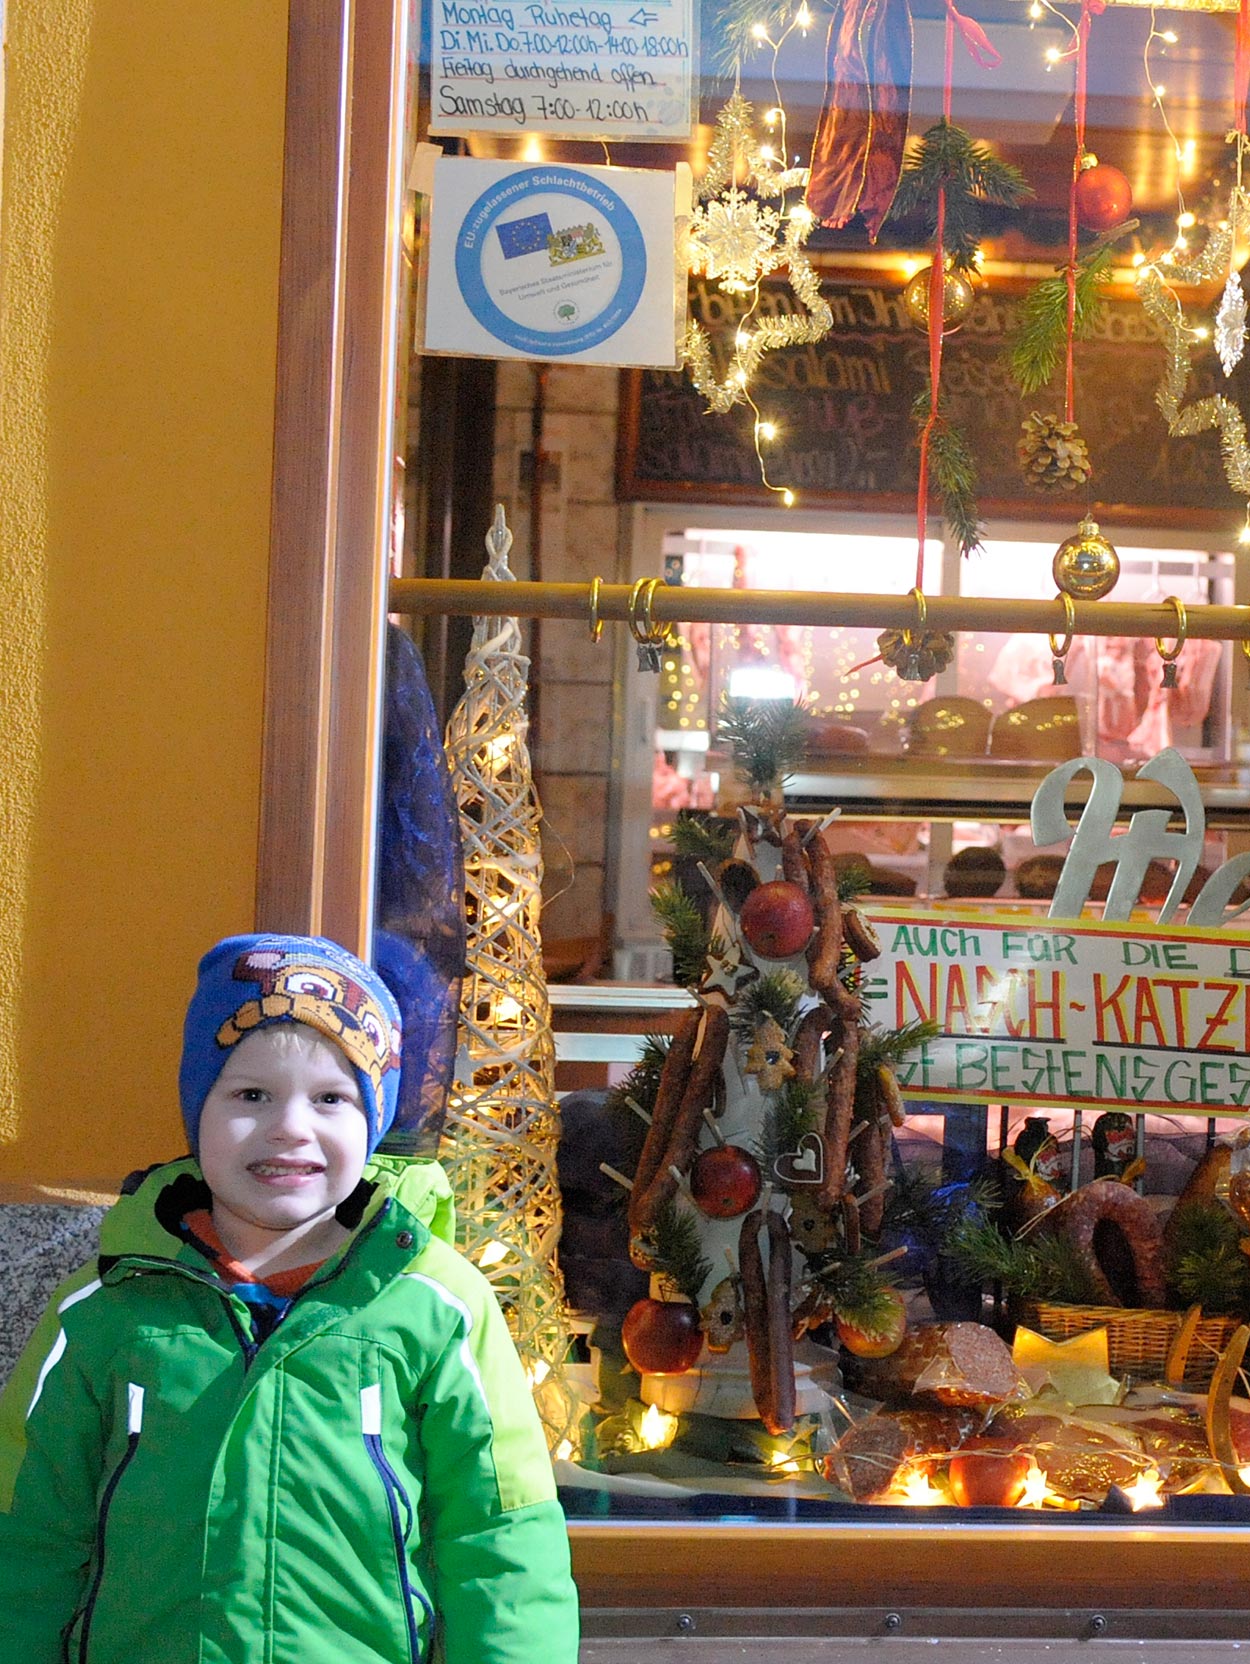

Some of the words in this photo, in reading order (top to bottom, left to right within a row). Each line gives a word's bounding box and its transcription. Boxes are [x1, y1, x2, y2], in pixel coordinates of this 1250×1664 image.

[442, 2, 515, 31] Montag
[525, 4, 613, 34] Ruhetag
[505, 58, 601, 89] durchgehend
[611, 62, 657, 93] offen
[440, 85, 526, 124] Samstag
[464, 180, 530, 249] EU-zugelassener
[532, 175, 616, 212] Schlachtbetrieb
[1121, 941, 1198, 970] DIE
